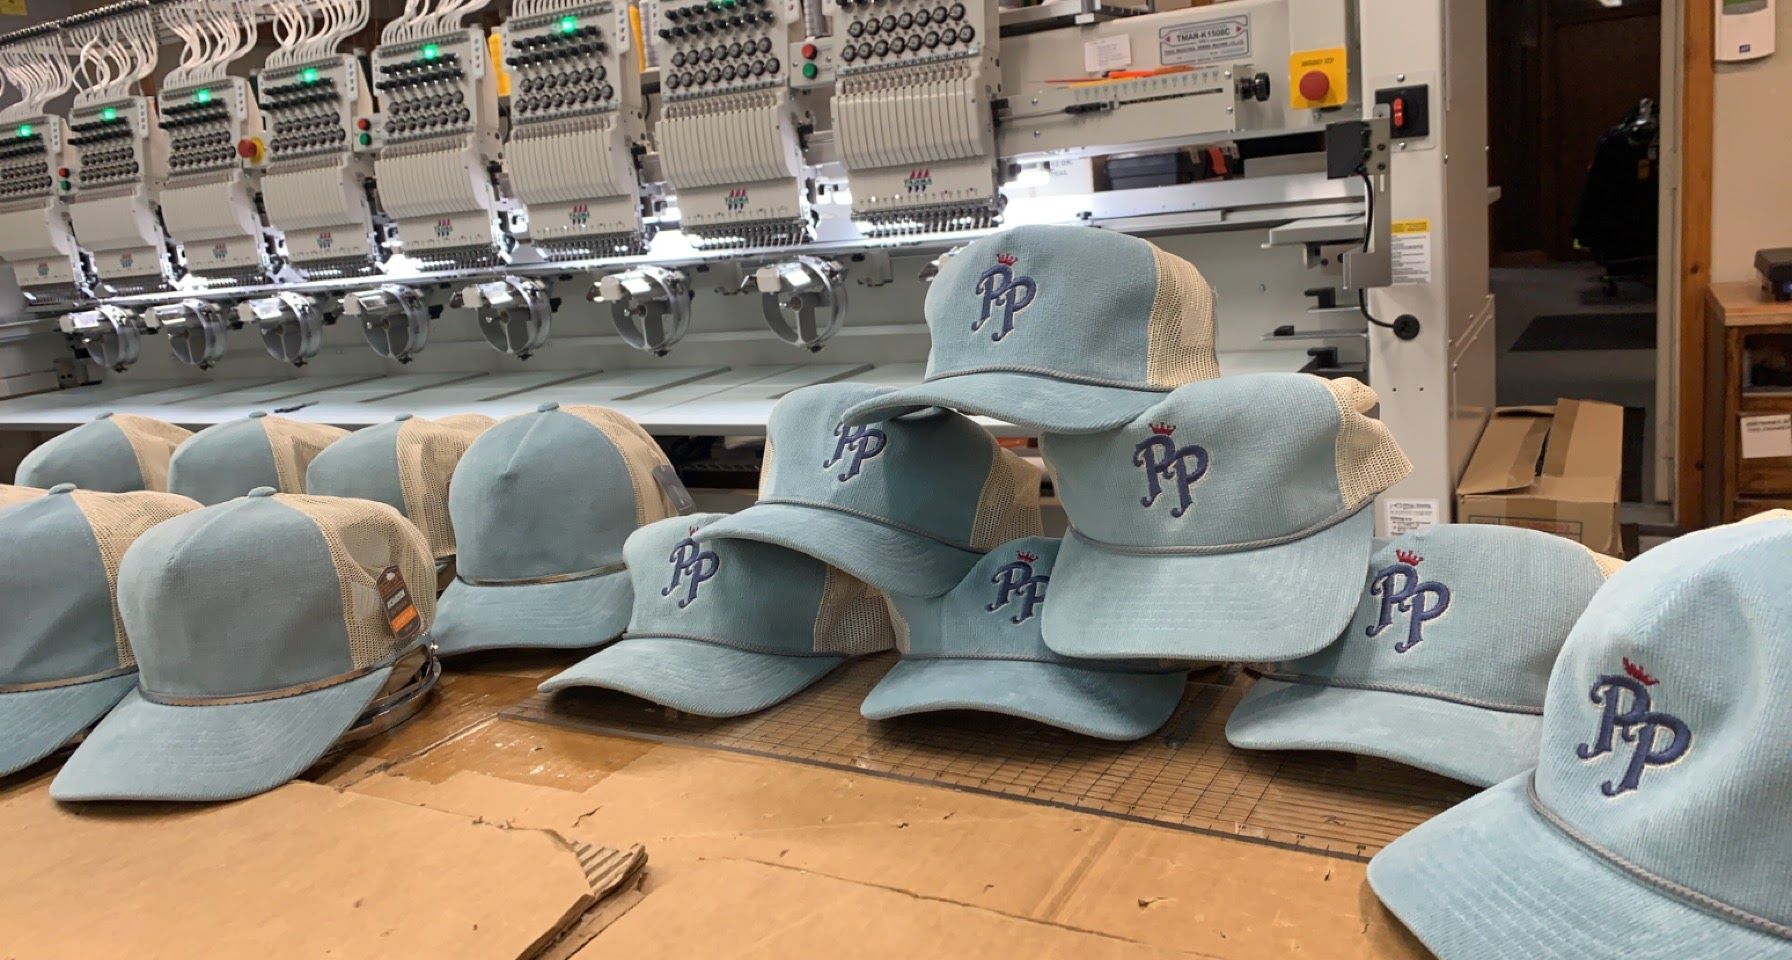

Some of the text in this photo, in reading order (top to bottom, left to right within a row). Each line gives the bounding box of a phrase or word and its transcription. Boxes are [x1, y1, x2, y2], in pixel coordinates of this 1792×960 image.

[971, 264, 1037, 342] PP
[1133, 435, 1209, 518] PP
[1365, 564, 1451, 654] PP
[1577, 675, 1693, 796] PP
